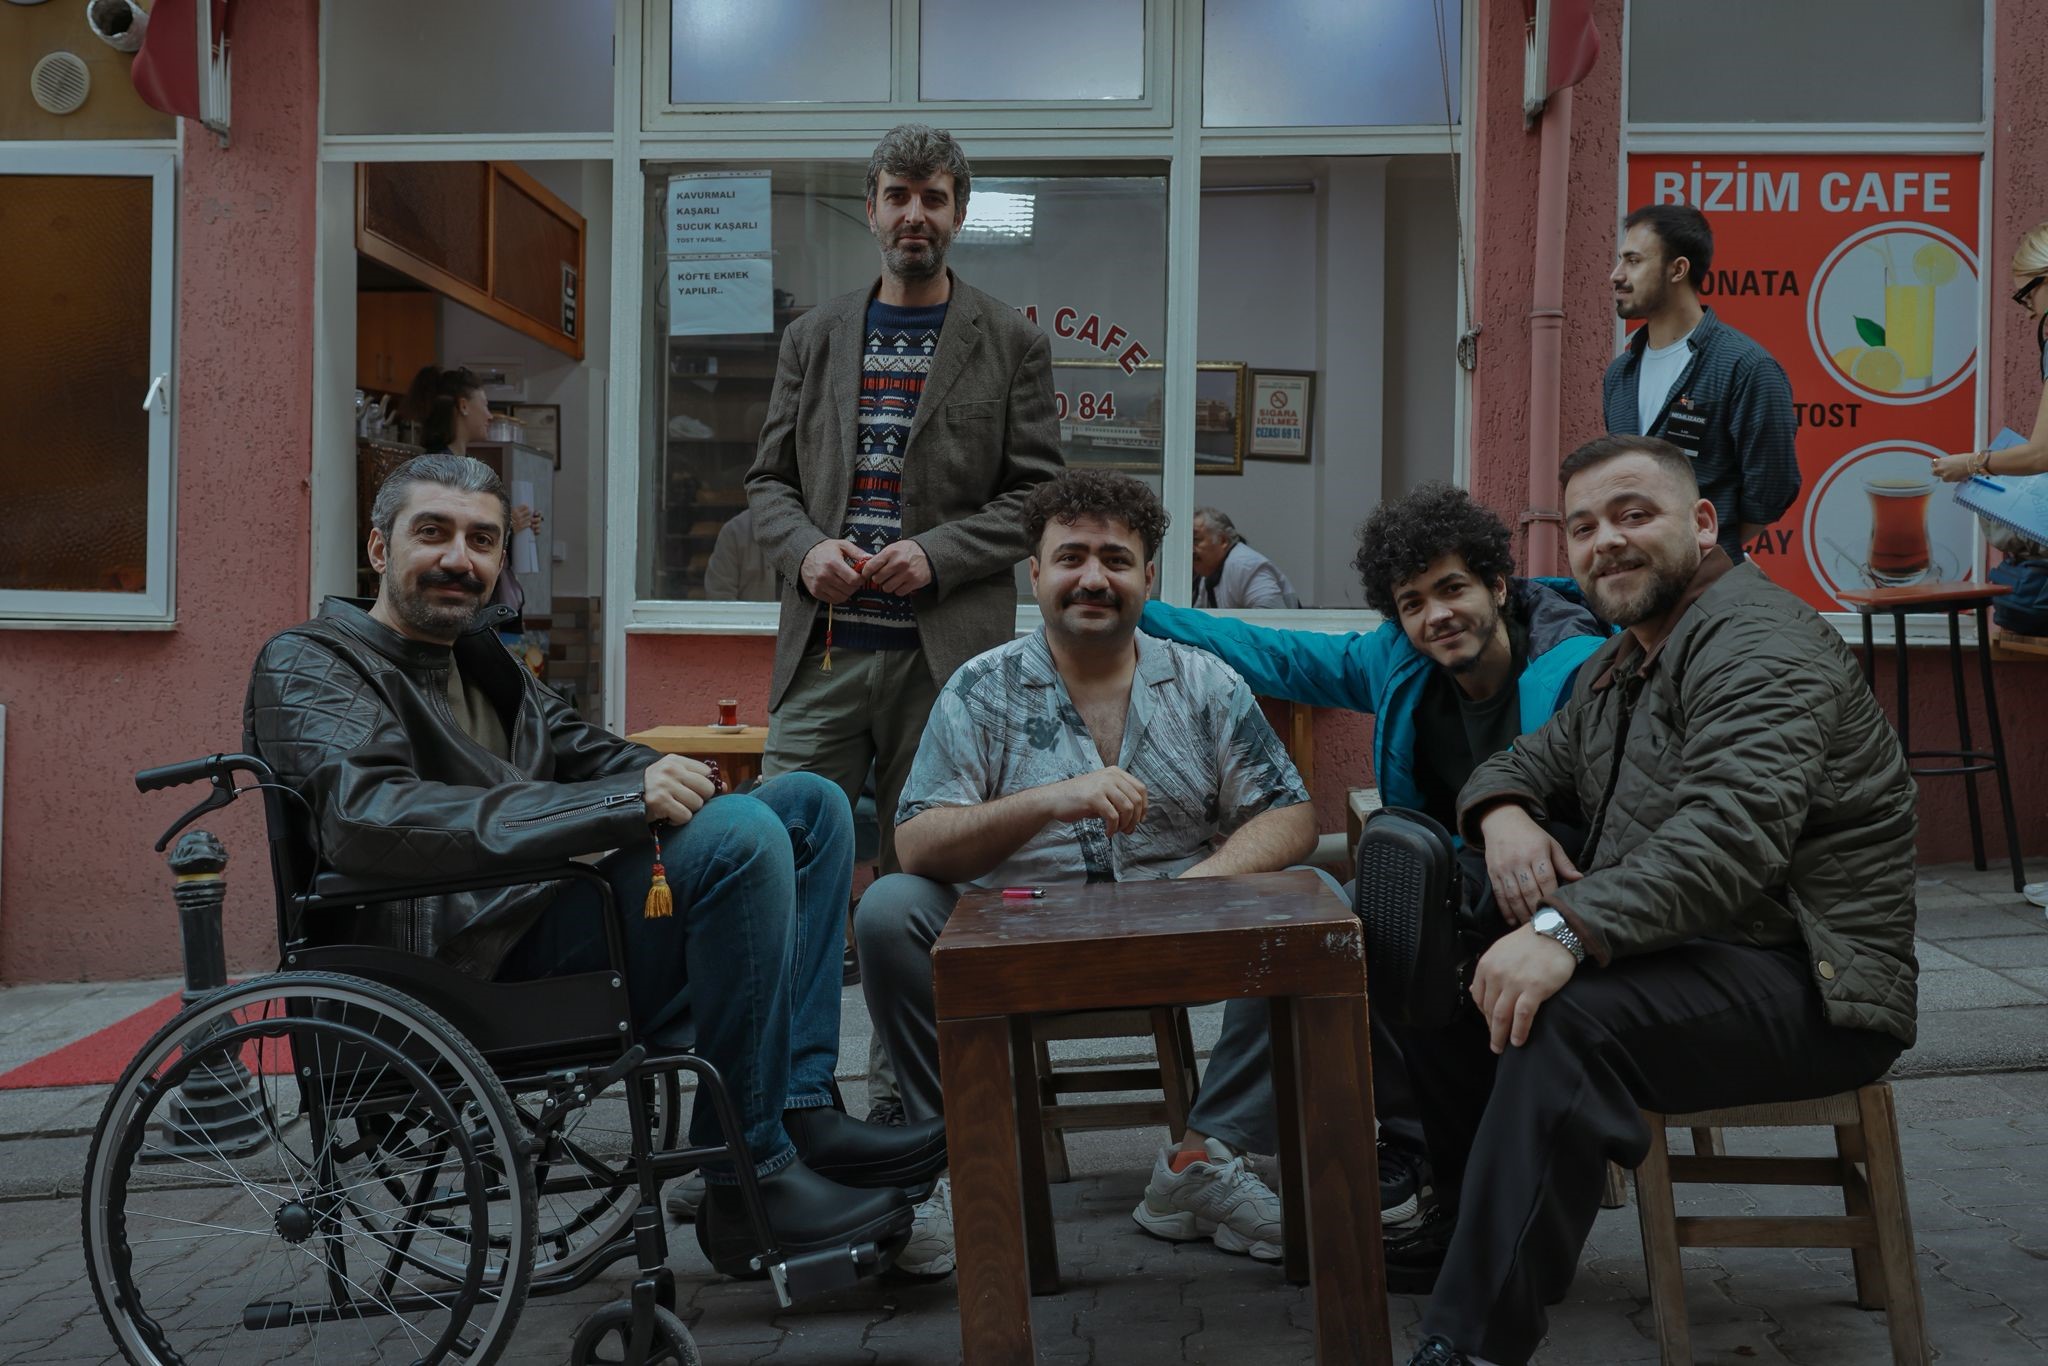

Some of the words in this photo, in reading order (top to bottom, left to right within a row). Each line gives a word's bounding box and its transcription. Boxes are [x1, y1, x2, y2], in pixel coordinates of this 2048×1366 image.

[676, 191, 736, 200] KAVURMALI
[1654, 160, 1799, 212] BİZİM
[1819, 171, 1950, 213] CAFE
[676, 207, 720, 216] KAŞARLI
[676, 223, 711, 231] SUCUK
[714, 222, 758, 231] KAŞARLI
[678, 272, 711, 280] KÖFTE
[714, 271, 749, 280] EKMEK
[1054, 306, 1150, 376] CAFE
[1079, 392, 1116, 420] 84
[1793, 403, 1862, 428] TOST
[1744, 529, 1794, 555] AY
